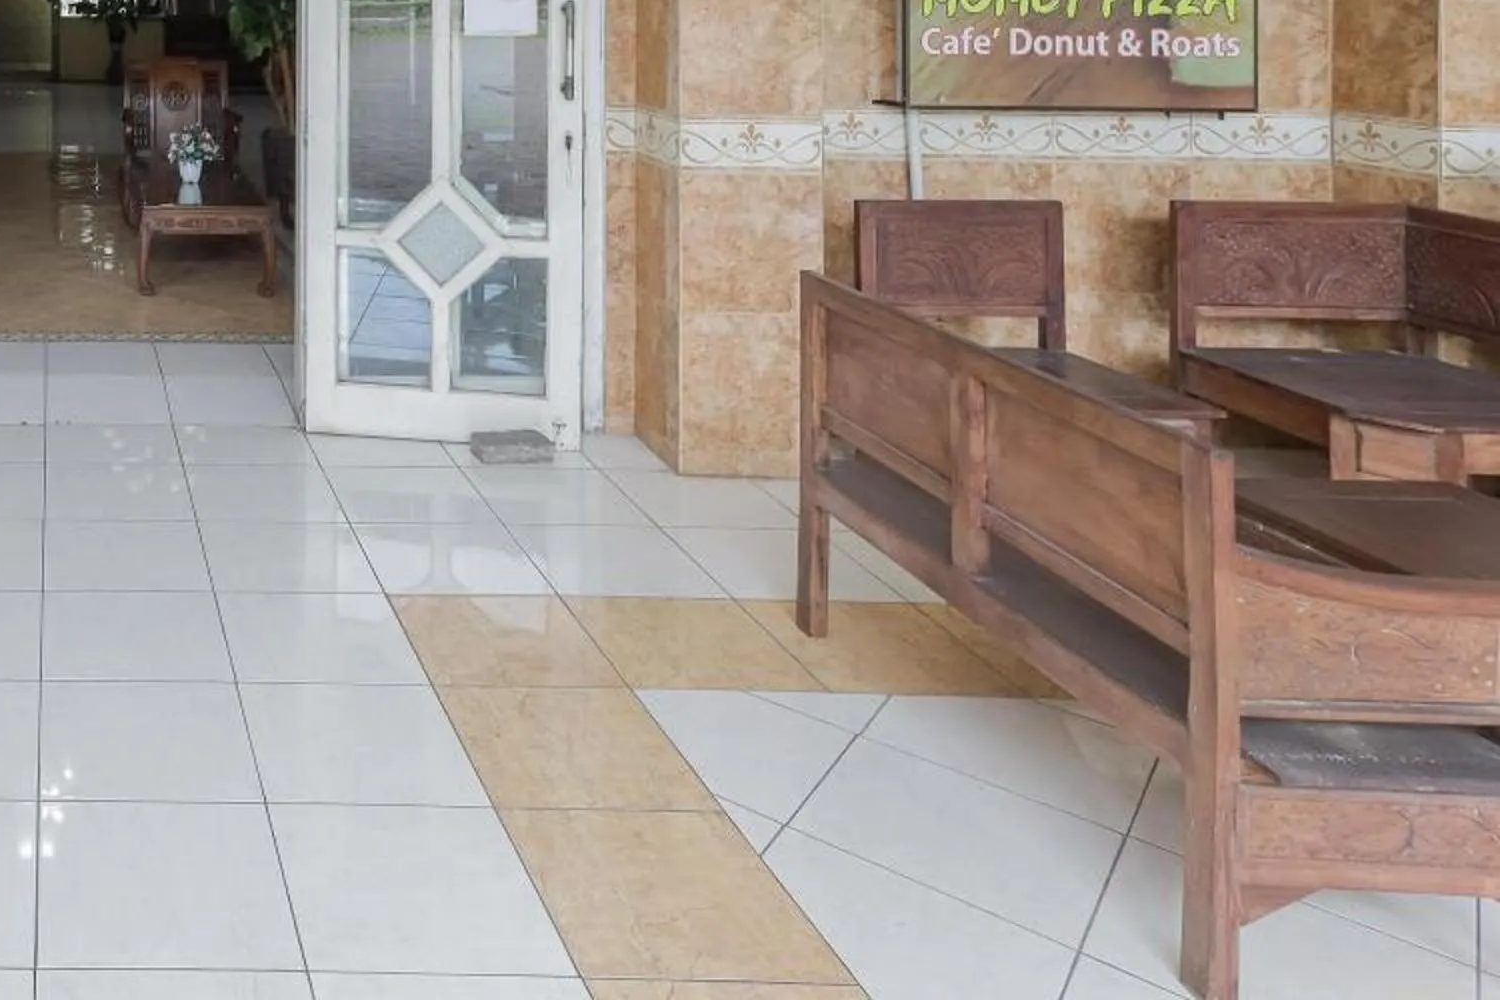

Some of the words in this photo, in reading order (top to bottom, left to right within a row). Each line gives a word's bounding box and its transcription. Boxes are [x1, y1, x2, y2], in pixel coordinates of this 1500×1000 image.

[1009, 28, 1109, 57] Donut
[1117, 29, 1143, 57] &
[1151, 29, 1241, 57] Roats
